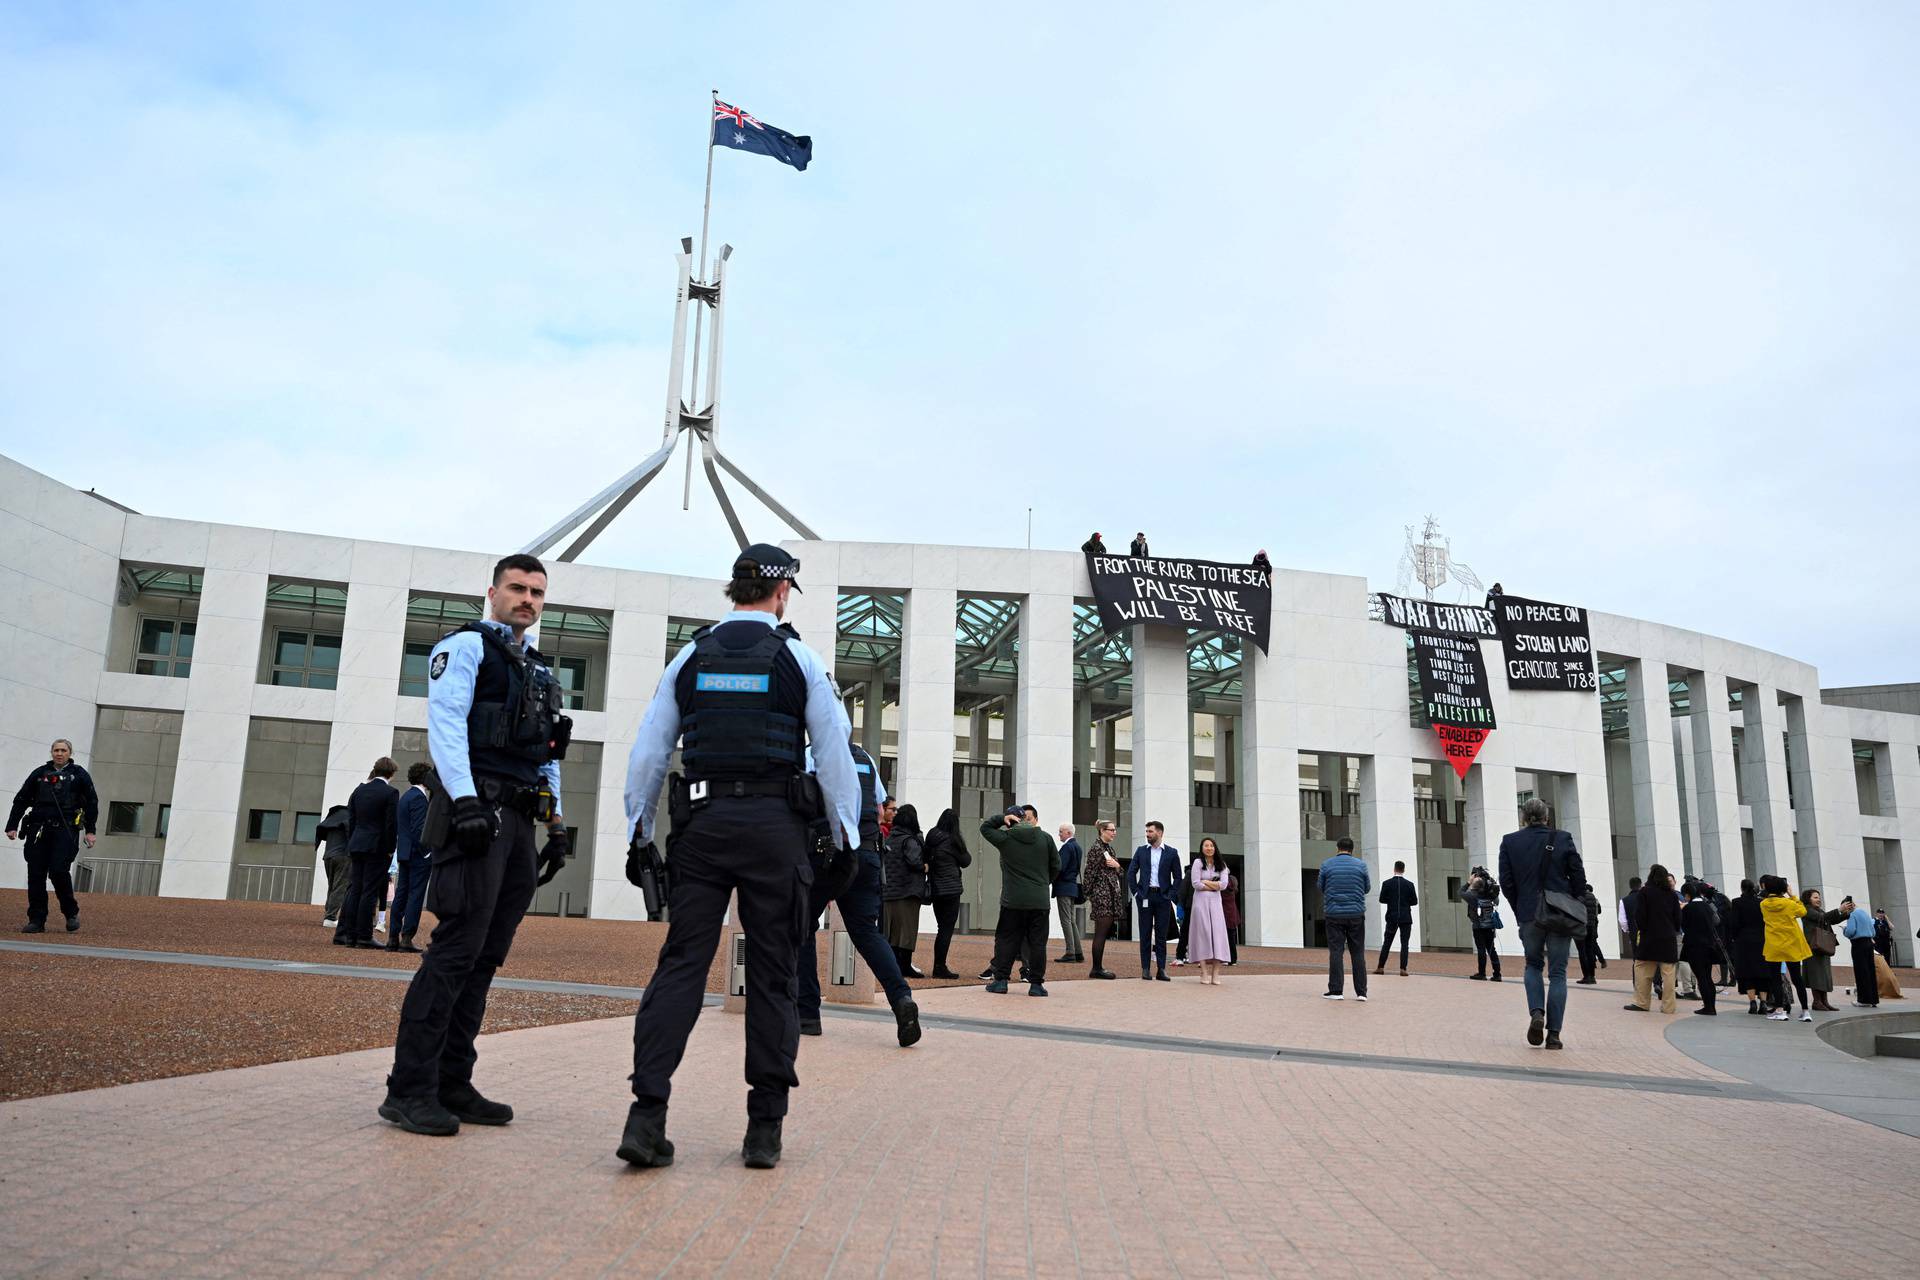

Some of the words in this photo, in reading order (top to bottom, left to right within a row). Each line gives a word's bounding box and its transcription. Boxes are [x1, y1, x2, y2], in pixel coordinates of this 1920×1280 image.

[1094, 557, 1131, 574] FROM
[1130, 558, 1158, 576] THE
[1159, 561, 1196, 580] RIVER
[1198, 566, 1217, 582] TO
[1218, 567, 1241, 584] THE
[1242, 569, 1269, 588] SEA
[1133, 577, 1246, 612] PALESTINE
[1114, 601, 1165, 620] WILL
[1177, 605, 1202, 622] BE
[1214, 610, 1256, 635] FREE
[1385, 596, 1431, 628] WAR
[1433, 606, 1497, 635] CRIMES
[1505, 605, 1523, 621] NO
[1525, 605, 1561, 621] PEACE
[1564, 607, 1580, 622] ON
[1420, 635, 1455, 649] FRONTIER
[1455, 640, 1476, 652] WARS
[1515, 634, 1556, 653] STOLEN
[1558, 636, 1589, 653] LAND
[1434, 648, 1464, 662] VIETNAM
[1429, 657, 1453, 671] TIMOR
[1508, 660, 1560, 679] GENOCIDE
[1563, 662, 1584, 671] SINCE
[704, 680, 760, 690] POLICE
[1431, 670, 1451, 682] WEST
[1452, 672, 1476, 685] PAPUA
[1567, 672, 1596, 688] 1788
[1434, 692, 1482, 708] AFGHANISTAN
[1428, 702, 1492, 723] PALESTINE
[1439, 726, 1483, 743] ENABLED
[1445, 743, 1475, 758] HERE
